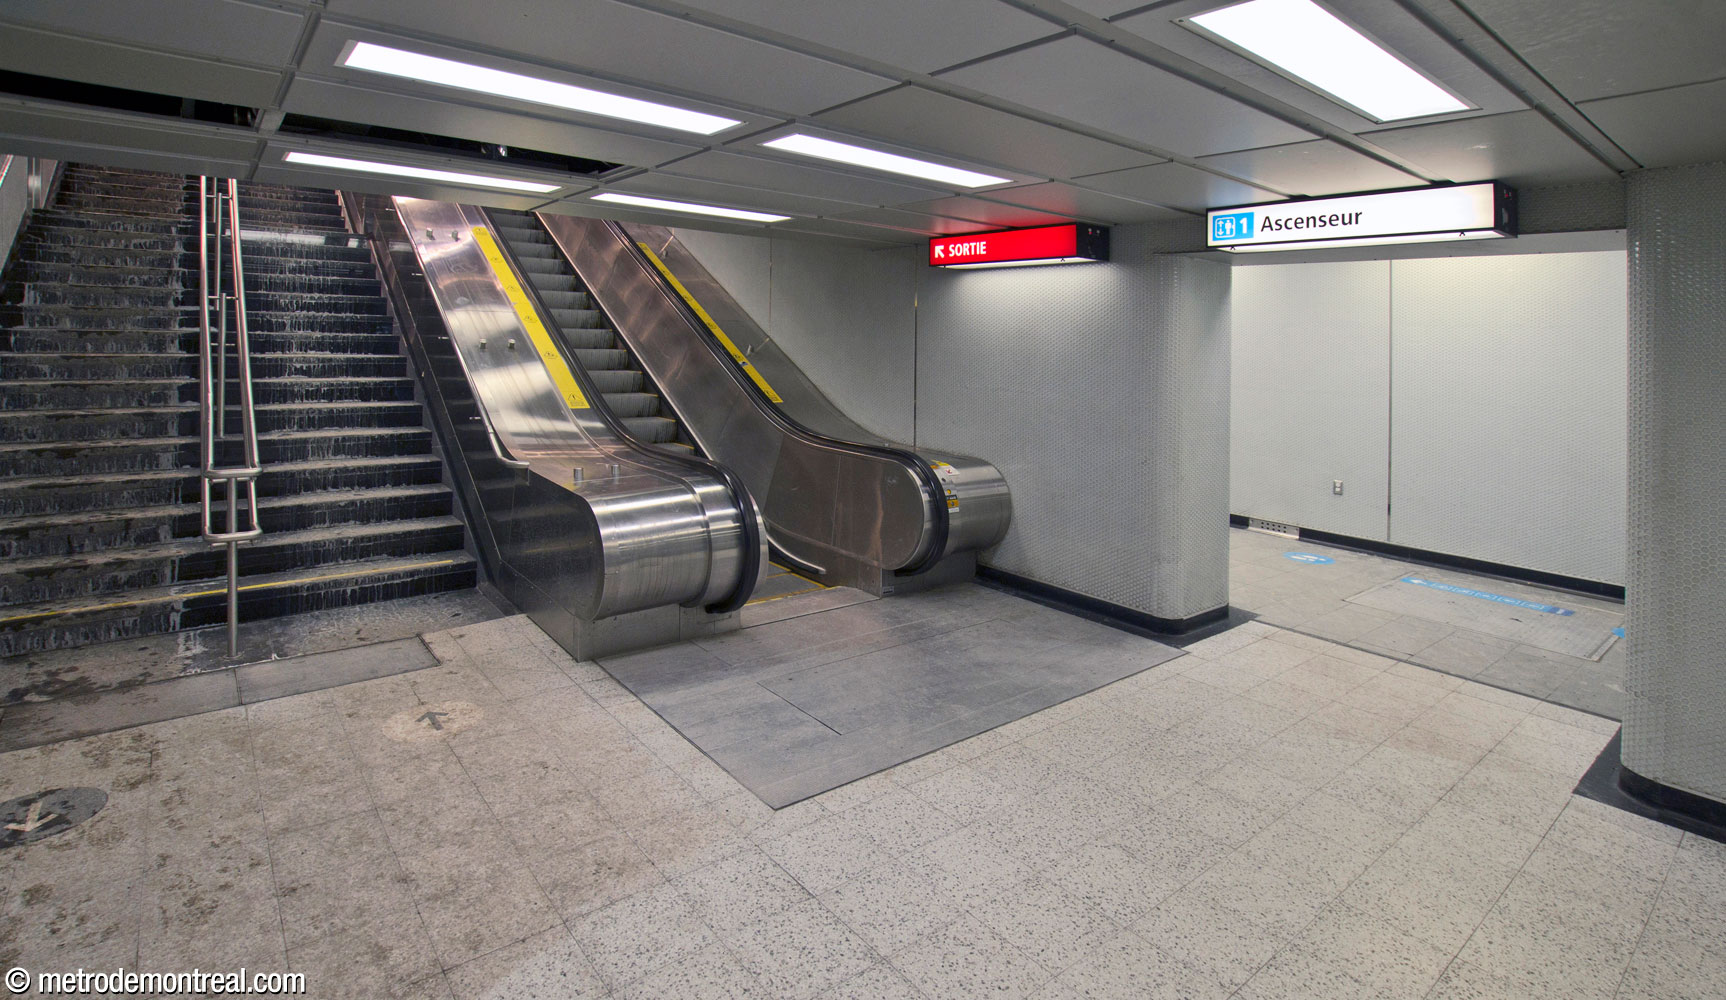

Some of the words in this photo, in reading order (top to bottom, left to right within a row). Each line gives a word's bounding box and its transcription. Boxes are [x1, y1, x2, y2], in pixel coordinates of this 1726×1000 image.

[1239, 217, 1249, 234] 1
[1260, 209, 1363, 232] Ascenseur
[948, 241, 987, 257] SORTIE
